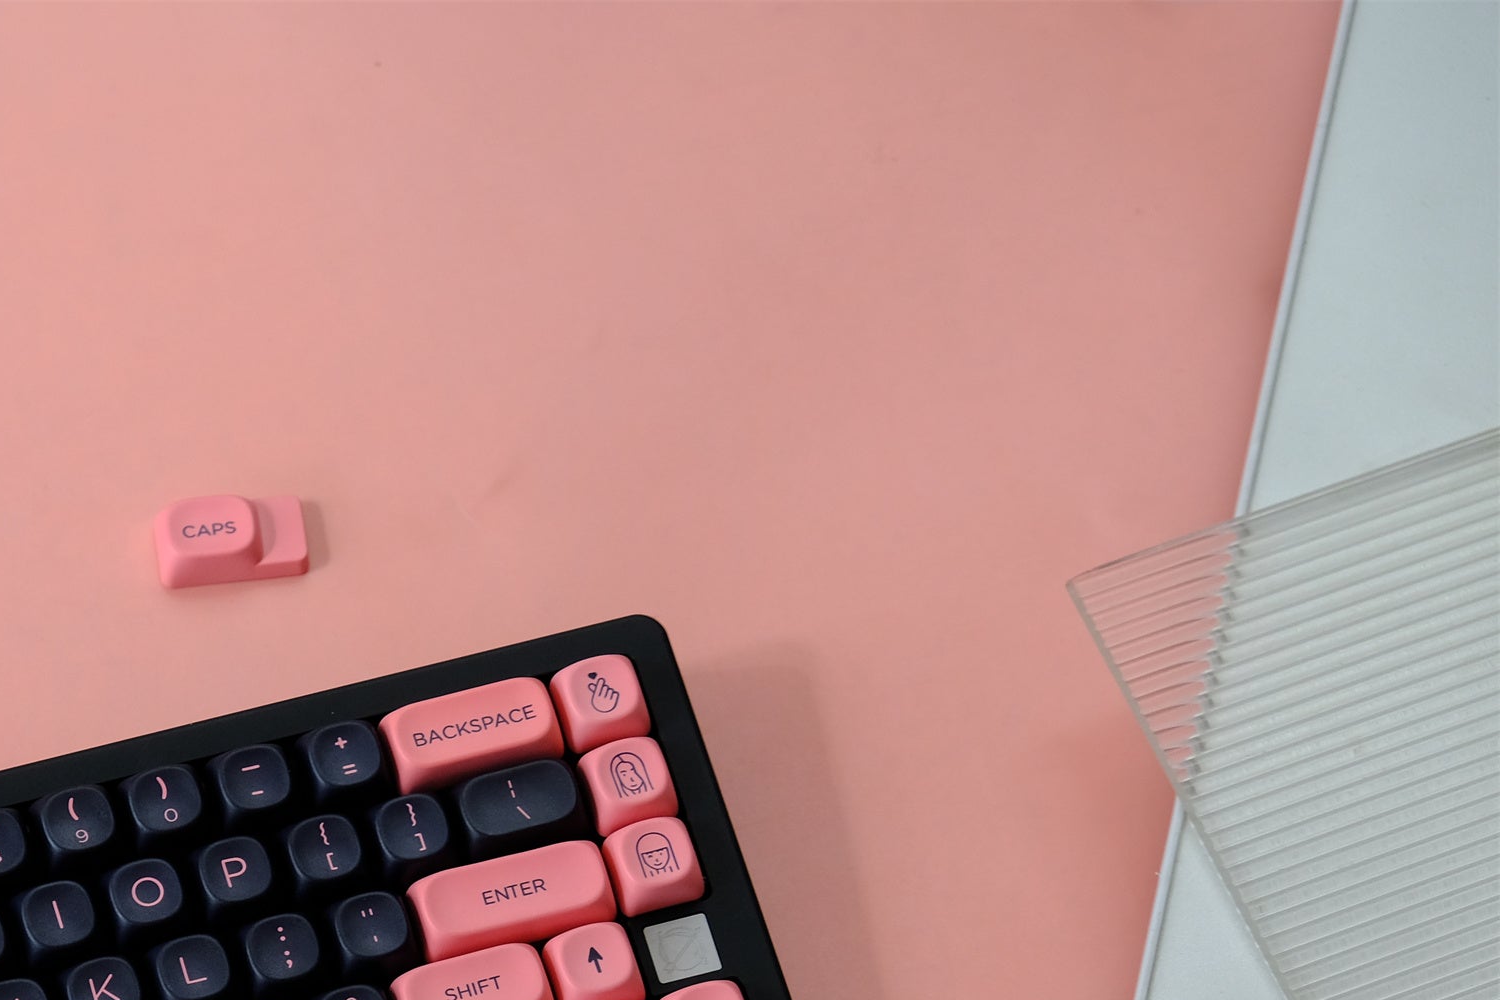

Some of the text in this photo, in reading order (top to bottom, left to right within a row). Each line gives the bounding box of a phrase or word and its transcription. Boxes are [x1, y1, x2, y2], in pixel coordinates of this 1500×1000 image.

[181, 521, 237, 539] CAPS
[412, 703, 538, 748] BACKSPACE
[334, 737, 348, 749] +
[342, 763, 358, 775] =
[156, 776, 168, 800] )
[68, 797, 79, 821] (
[406, 803, 417, 827] }
[516, 806, 531, 820] \
[75, 829, 89, 843] 9
[319, 822, 330, 846] {
[414, 832, 427, 851] ]
[221, 857, 247, 888] P
[326, 852, 338, 871] [
[131, 876, 165, 907] O
[481, 878, 547, 906] ENTER
[52, 900, 64, 929] I
[179, 957, 208, 985] L
